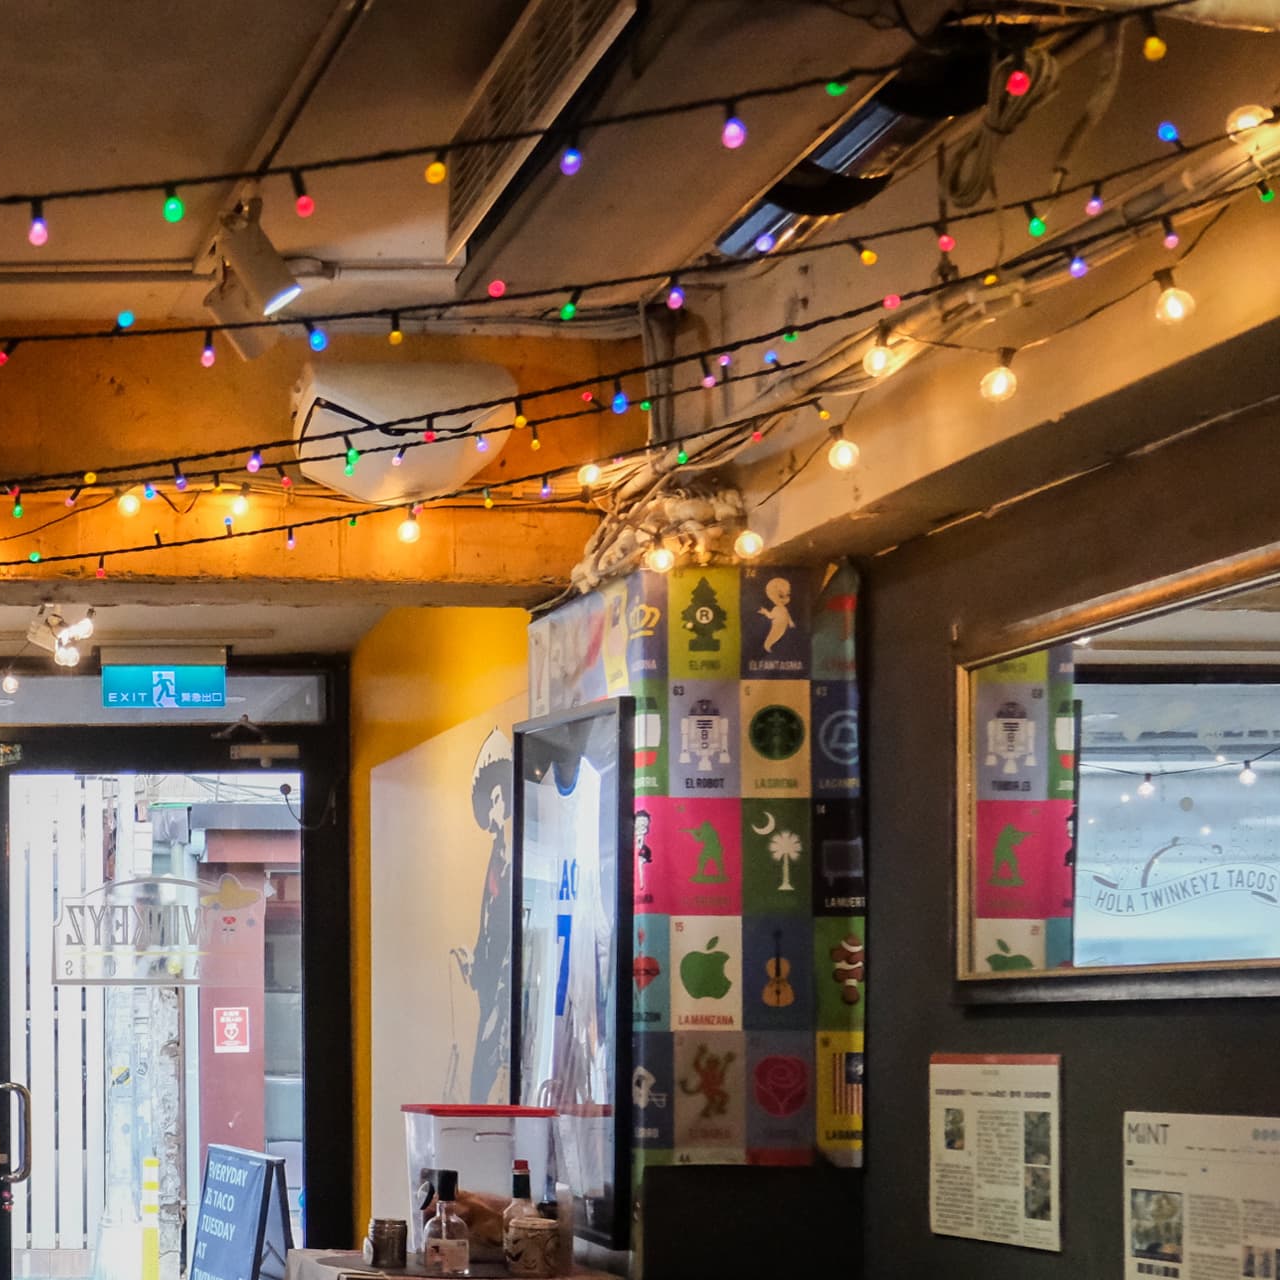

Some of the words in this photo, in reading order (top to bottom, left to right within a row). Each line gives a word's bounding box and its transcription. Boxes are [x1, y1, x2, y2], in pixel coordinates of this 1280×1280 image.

[108, 692, 147, 702] EXIT
[1095, 890, 1135, 912] HOLA
[1141, 872, 1220, 910] TWINKEYZ
[1227, 869, 1278, 892] TACOS
[555, 914, 572, 1016] 7
[690, 1015, 734, 1025] MANZANA
[208, 1160, 248, 1188] EVERYDAY
[214, 1190, 235, 1212] TACO
[201, 1214, 236, 1241] TUESDAY
[196, 1241, 207, 1260] AT
